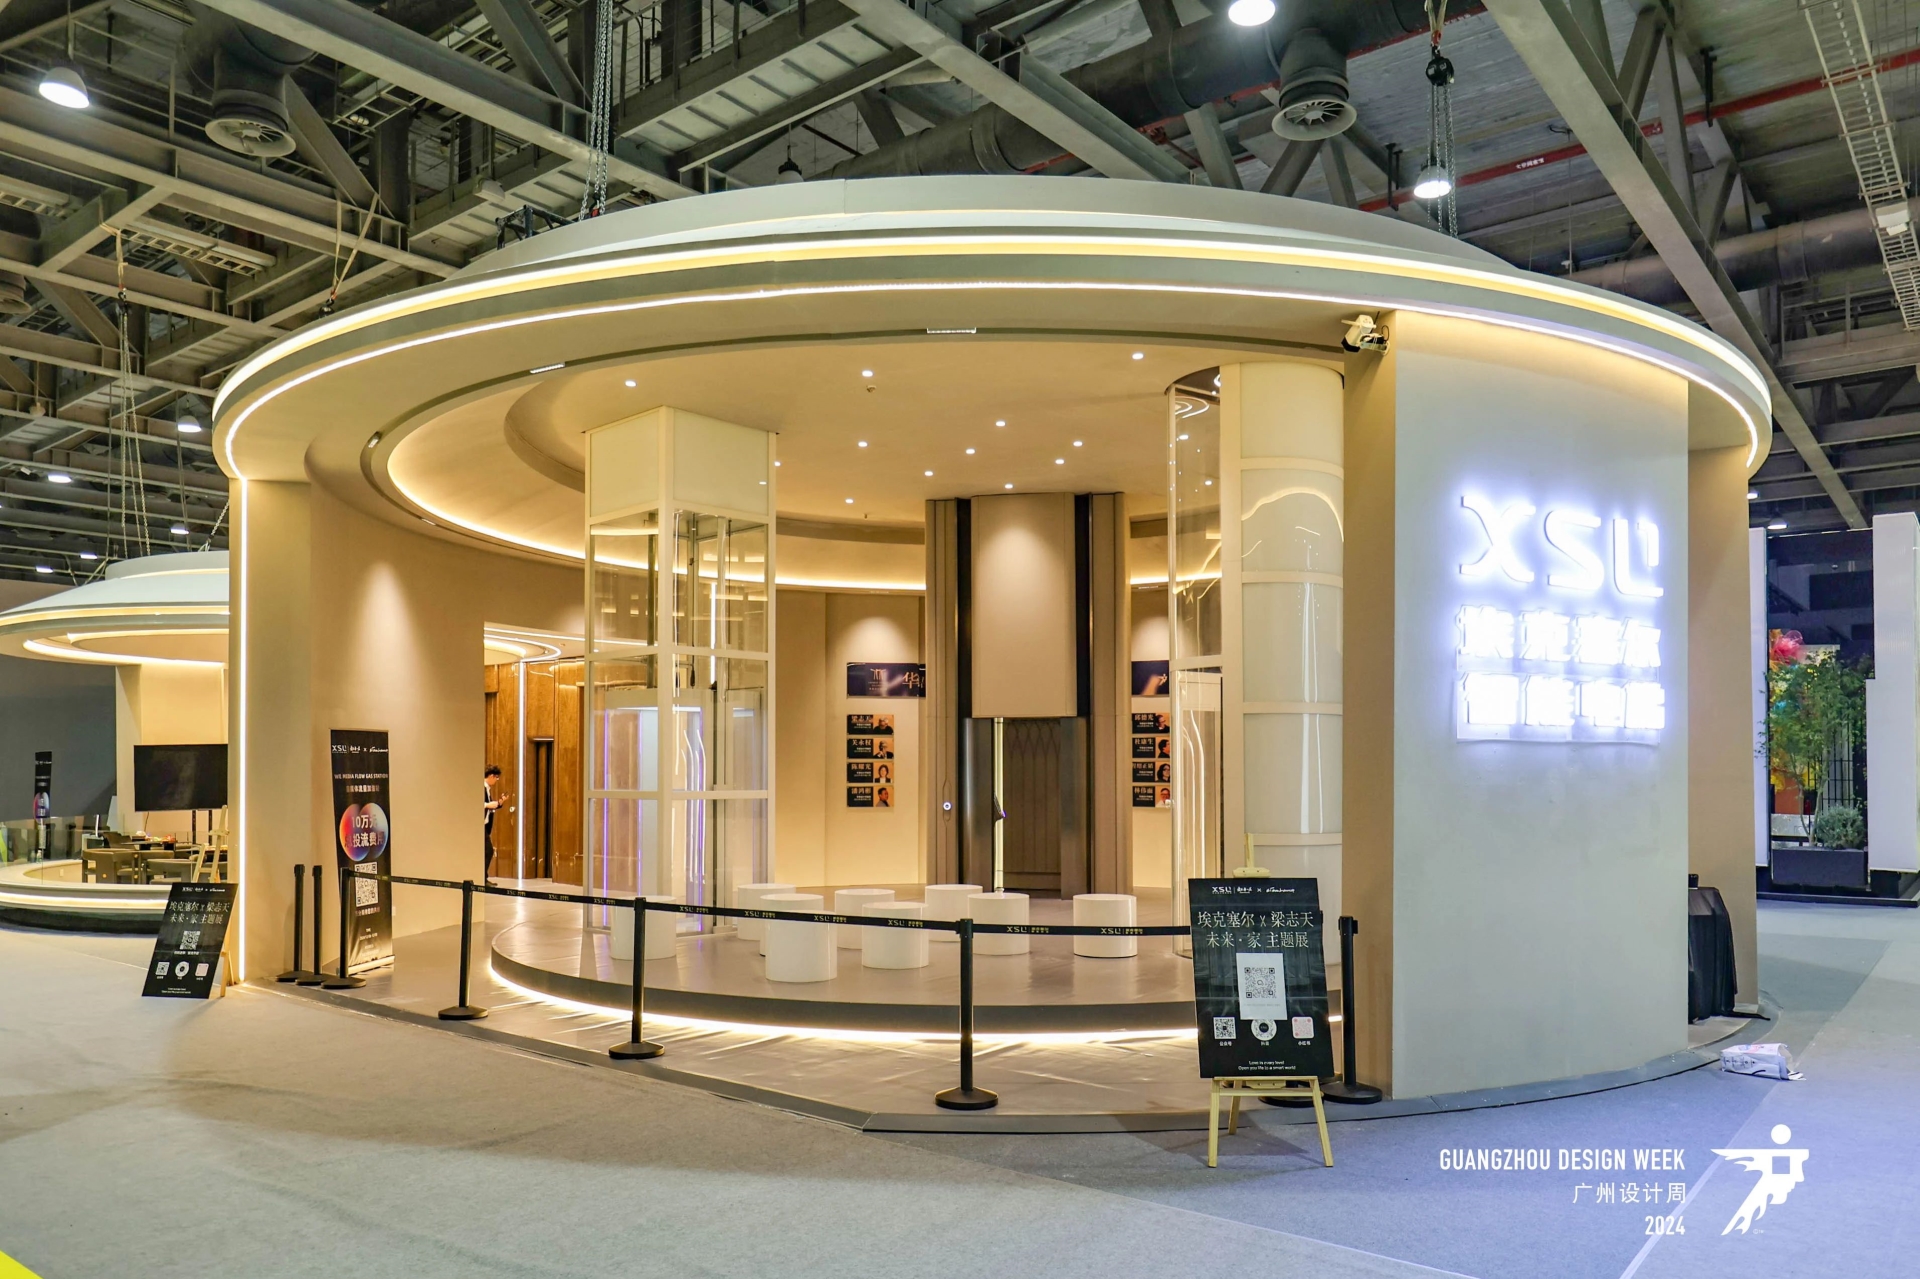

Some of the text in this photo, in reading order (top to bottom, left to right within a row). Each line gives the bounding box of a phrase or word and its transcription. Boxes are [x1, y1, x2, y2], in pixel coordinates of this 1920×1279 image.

[1197, 911, 1255, 928] 埃克塞尔
[1271, 911, 1314, 928] 梁志天
[1266, 931, 1309, 948] 主题展
